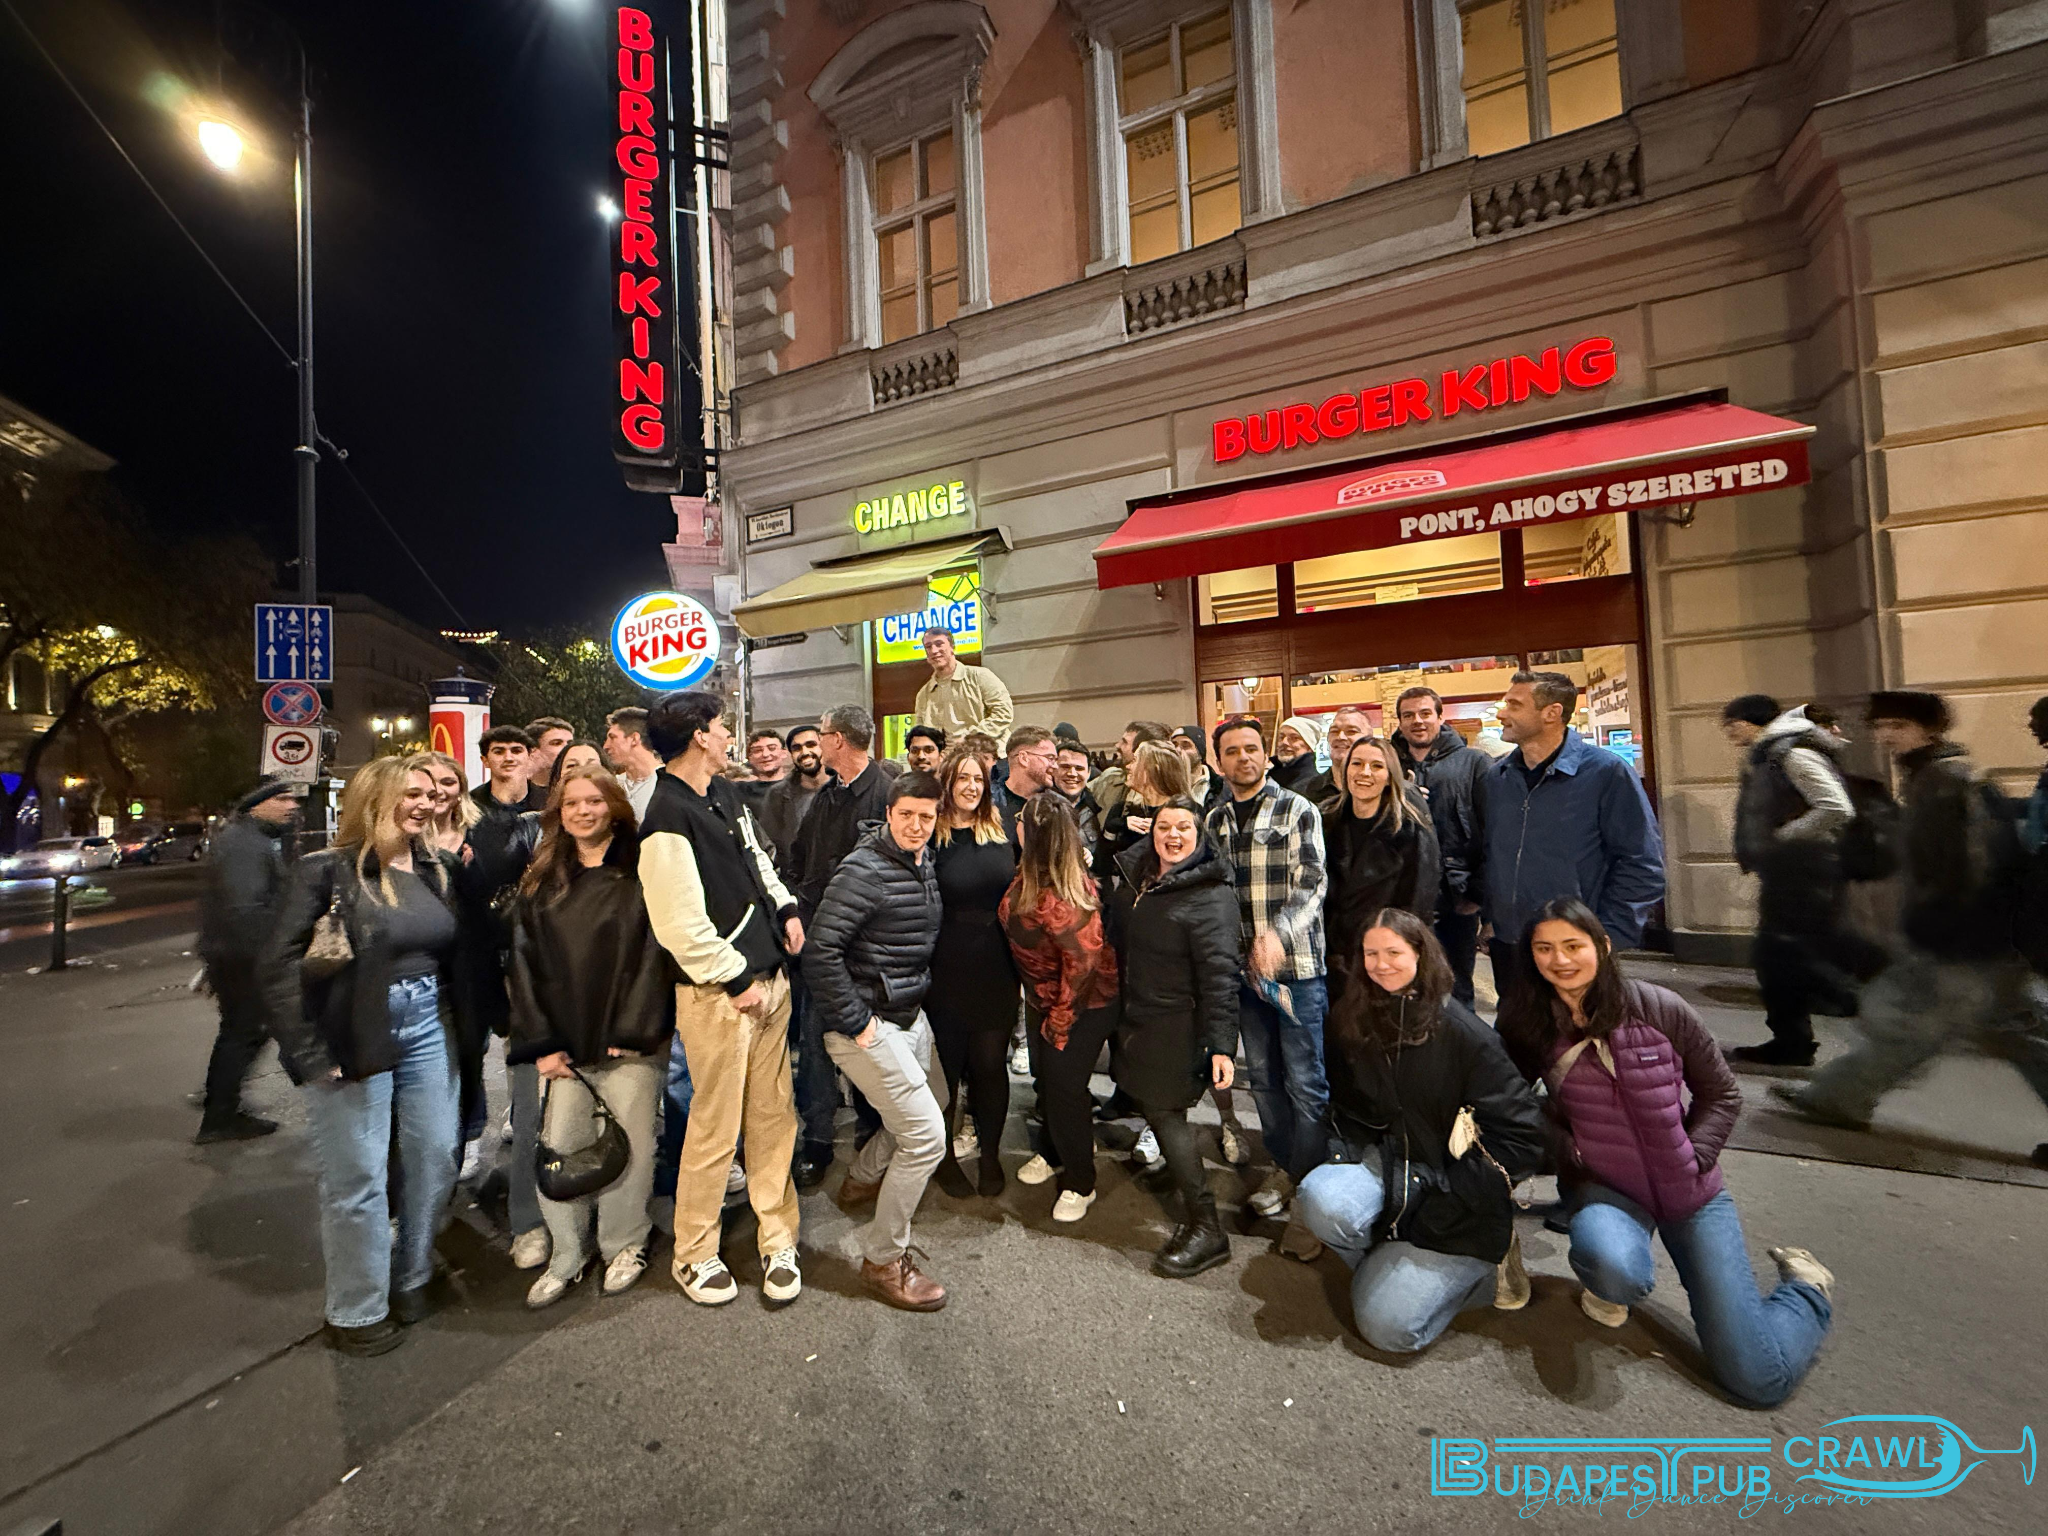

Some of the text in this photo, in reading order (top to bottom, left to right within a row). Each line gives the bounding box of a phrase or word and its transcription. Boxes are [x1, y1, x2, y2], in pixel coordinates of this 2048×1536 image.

[616, 7, 664, 449] BURGER KING
[1213, 337, 1617, 462] BURGER KING
[854, 480, 966, 534] CHANGE
[1400, 458, 1789, 540] PONT, AHOGY SZERETED
[756, 519, 784, 532] Oktogon
[624, 611, 703, 644] BURGER
[883, 601, 976, 643] CHANGE
[629, 627, 707, 669] KING
